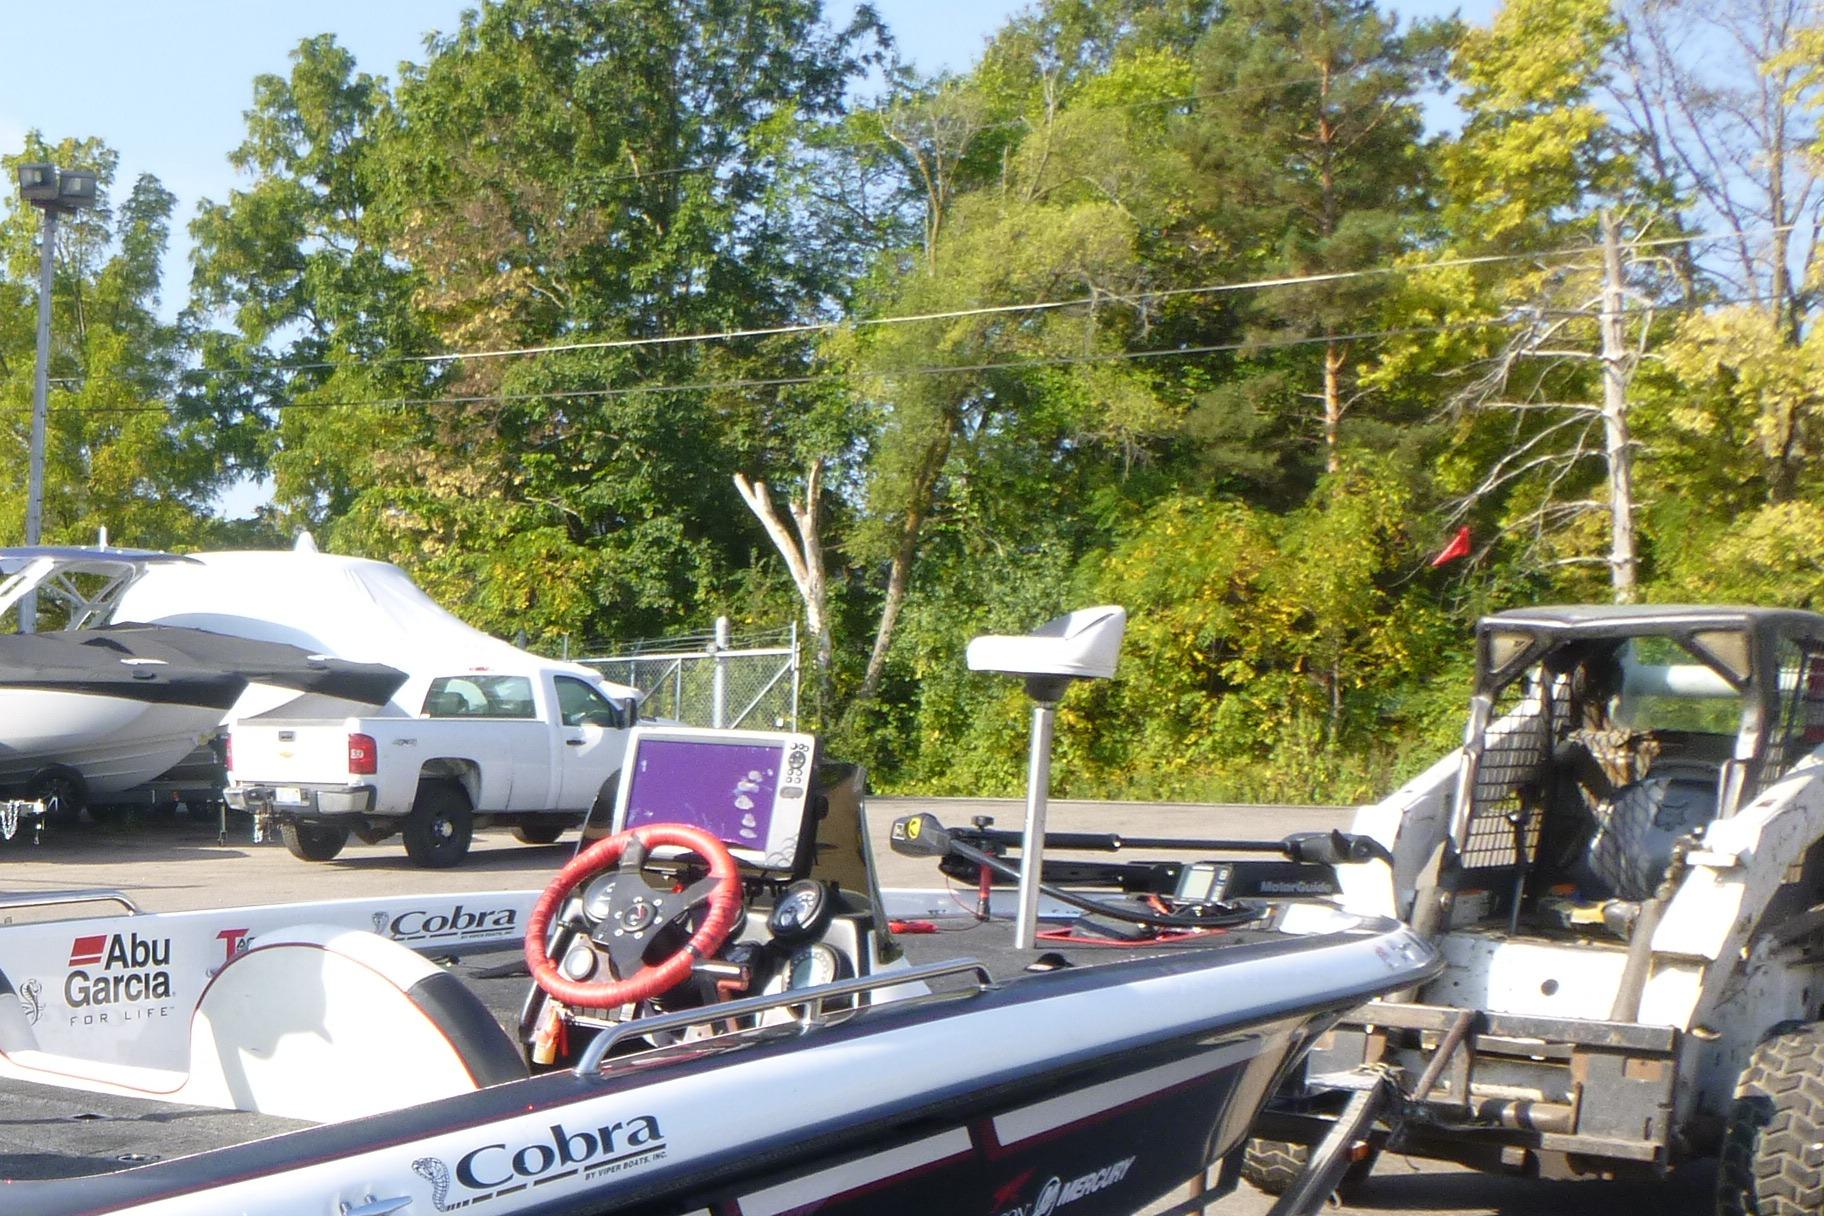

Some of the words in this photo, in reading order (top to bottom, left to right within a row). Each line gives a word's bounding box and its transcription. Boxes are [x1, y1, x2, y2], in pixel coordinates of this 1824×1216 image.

[390, 905, 517, 936] Cobra
[104, 932, 171, 971] Abu
[64, 969, 172, 1009] Garcia
[70, 1013, 108, 1026] FOR
[124, 1006, 170, 1021] LIFE
[455, 1114, 665, 1189] Cobra
[585, 1171, 596, 1181] BY
[598, 1164, 622, 1177] VIPER
[1056, 1155, 1136, 1207] MERCURY
